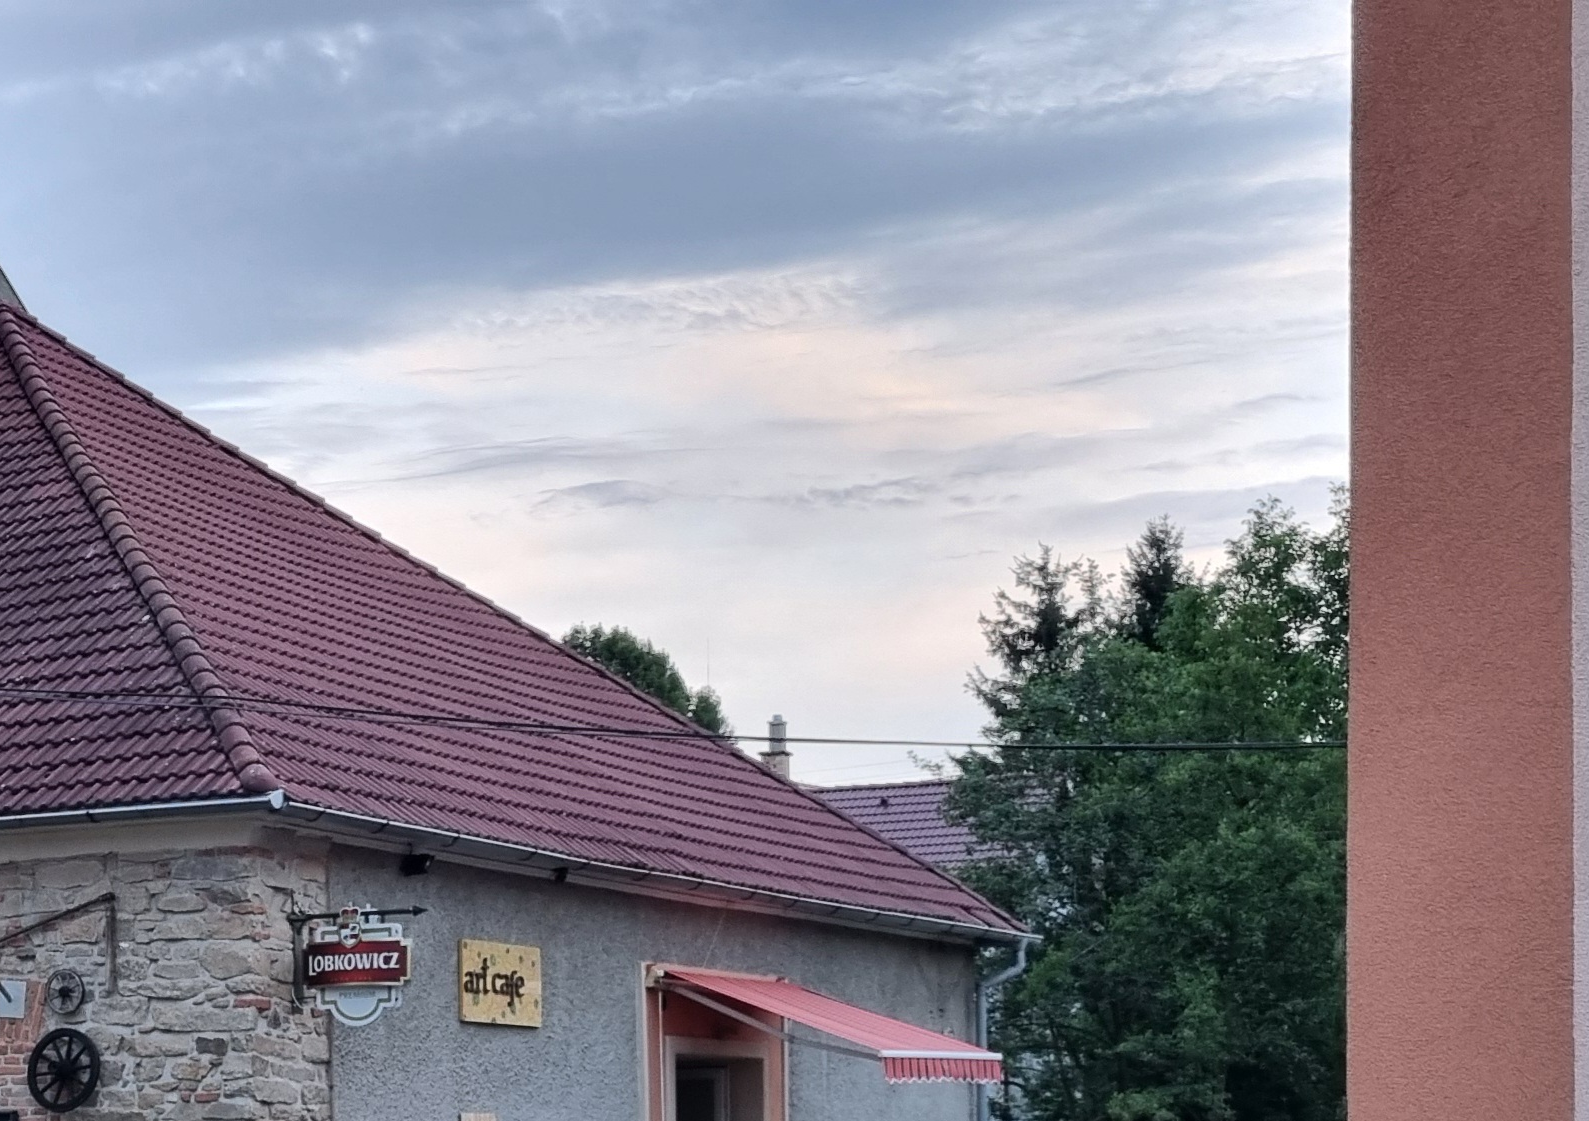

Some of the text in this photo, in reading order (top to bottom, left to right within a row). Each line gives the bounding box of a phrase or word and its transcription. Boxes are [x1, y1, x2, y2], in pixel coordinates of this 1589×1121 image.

[308, 952, 400, 976] LOBKOWICZ
[464, 957, 525, 1007] art cafe
